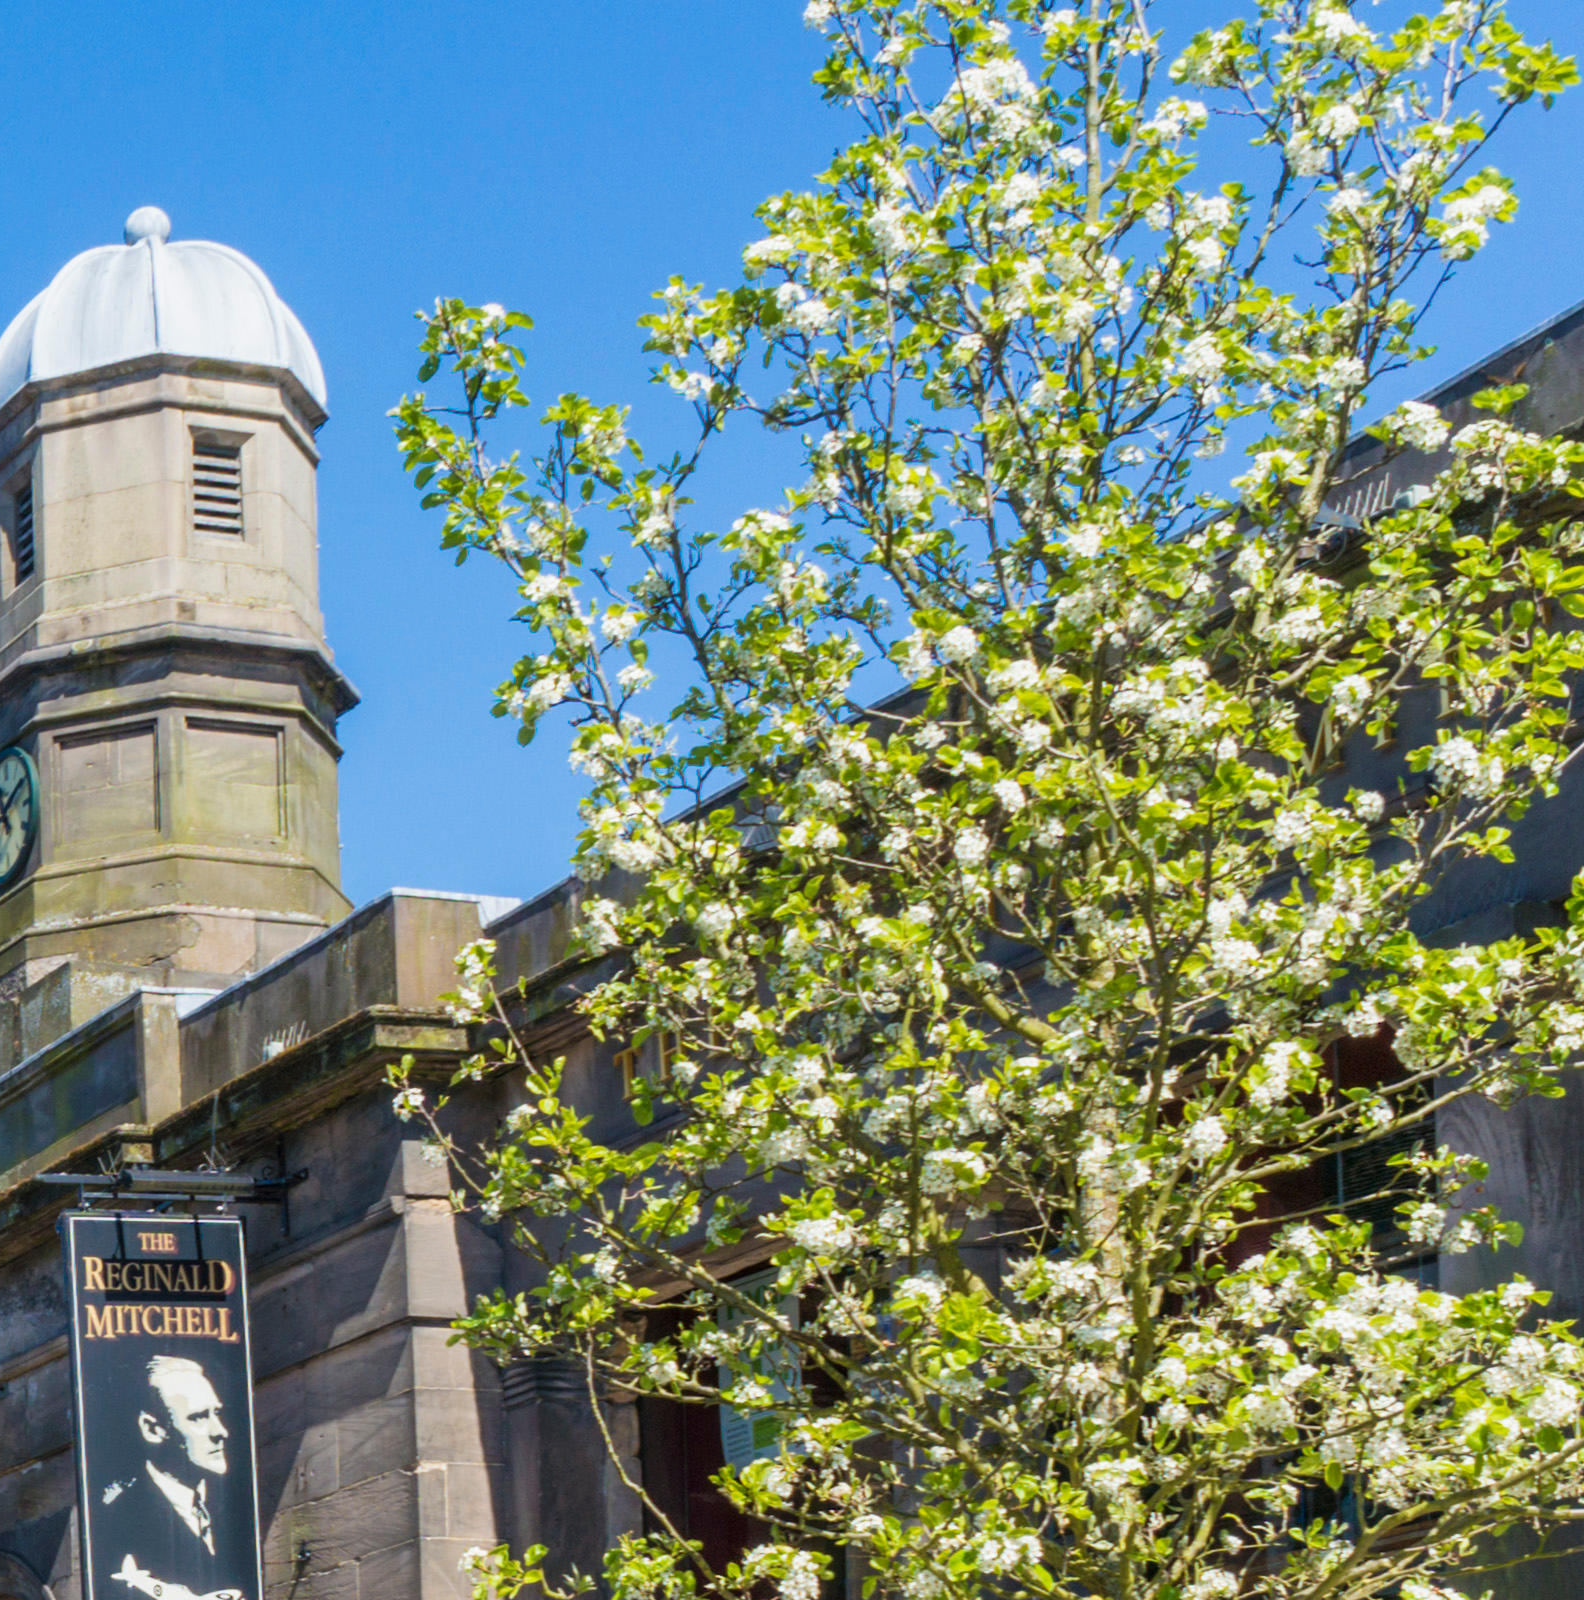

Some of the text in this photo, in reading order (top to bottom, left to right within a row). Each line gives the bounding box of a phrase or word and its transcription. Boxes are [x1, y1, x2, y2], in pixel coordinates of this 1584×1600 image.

[137, 1232, 178, 1253] THE
[82, 1256, 235, 1294] REGINALD
[84, 1304, 239, 1343] MITCHELL
